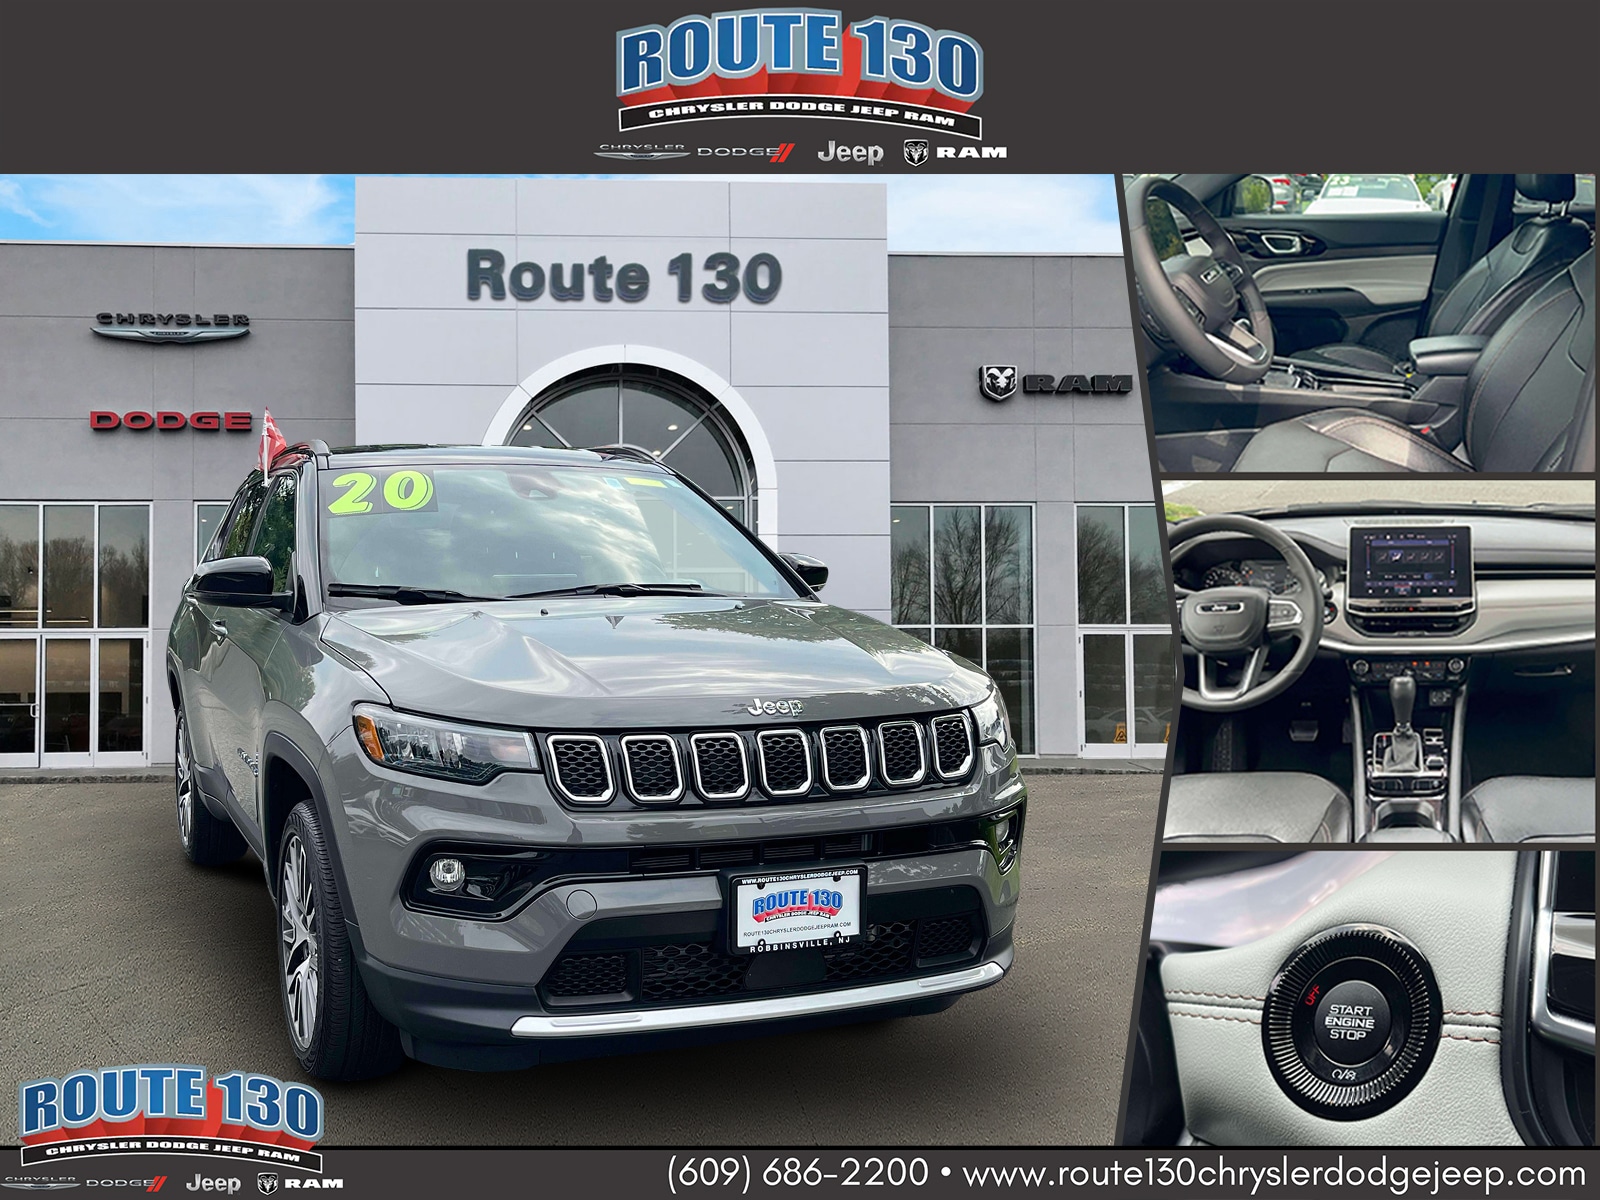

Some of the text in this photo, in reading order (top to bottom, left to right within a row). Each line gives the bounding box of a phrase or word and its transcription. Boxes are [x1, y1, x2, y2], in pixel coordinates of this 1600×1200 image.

[466, 248, 782, 305] Route 130
[96, 312, 250, 326] CHRYSLER
[1023, 374, 1133, 393] RAM
[90, 410, 253, 432] DODGE
[328, 470, 434, 515] 20
[747, 698, 804, 717] Jeep
[753, 888, 843, 915] ROUTE 130
[838, 936, 850, 944] NJ
[1304, 984, 1321, 1006] OFF
[1330, 1004, 1373, 1016] START
[1325, 1016, 1375, 1029] ENGINE
[1330, 1029, 1367, 1040] STOP
